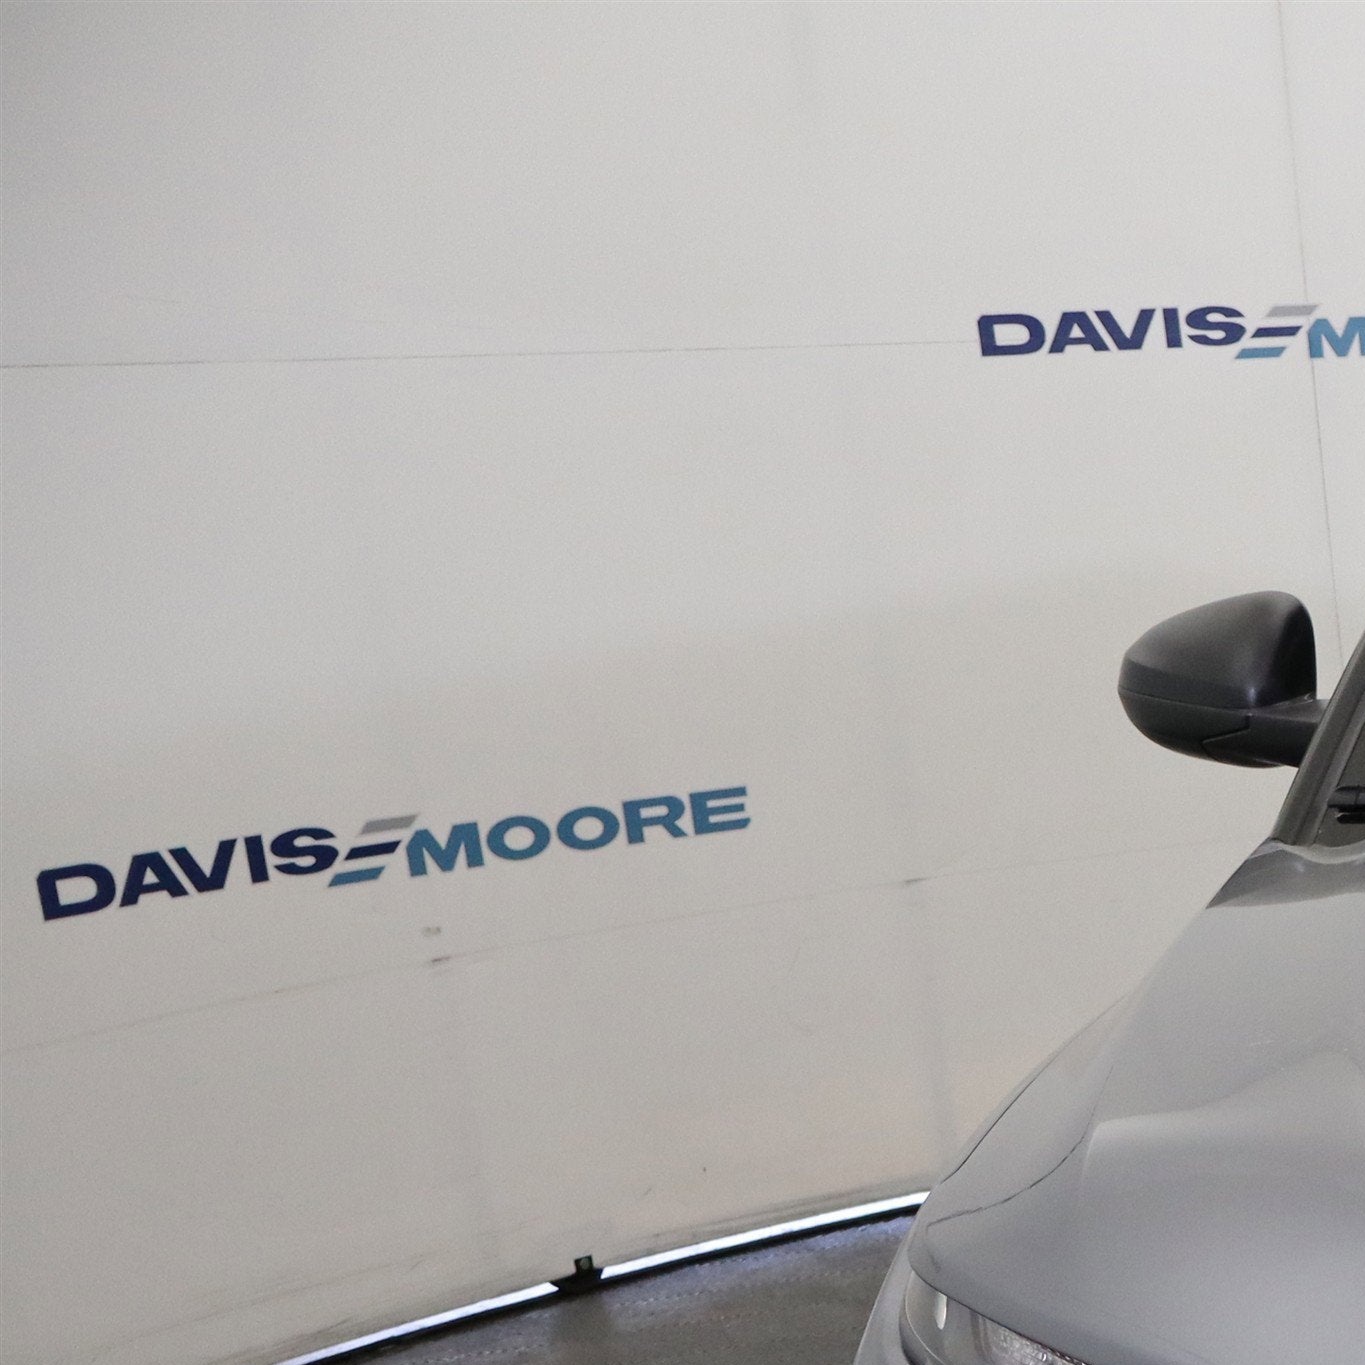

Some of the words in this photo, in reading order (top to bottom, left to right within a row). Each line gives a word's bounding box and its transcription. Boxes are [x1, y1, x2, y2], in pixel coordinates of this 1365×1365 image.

[977, 305, 1246, 357] DAVIS
[36, 826, 340, 921] DAVIS
[405, 785, 751, 878] MOORE
